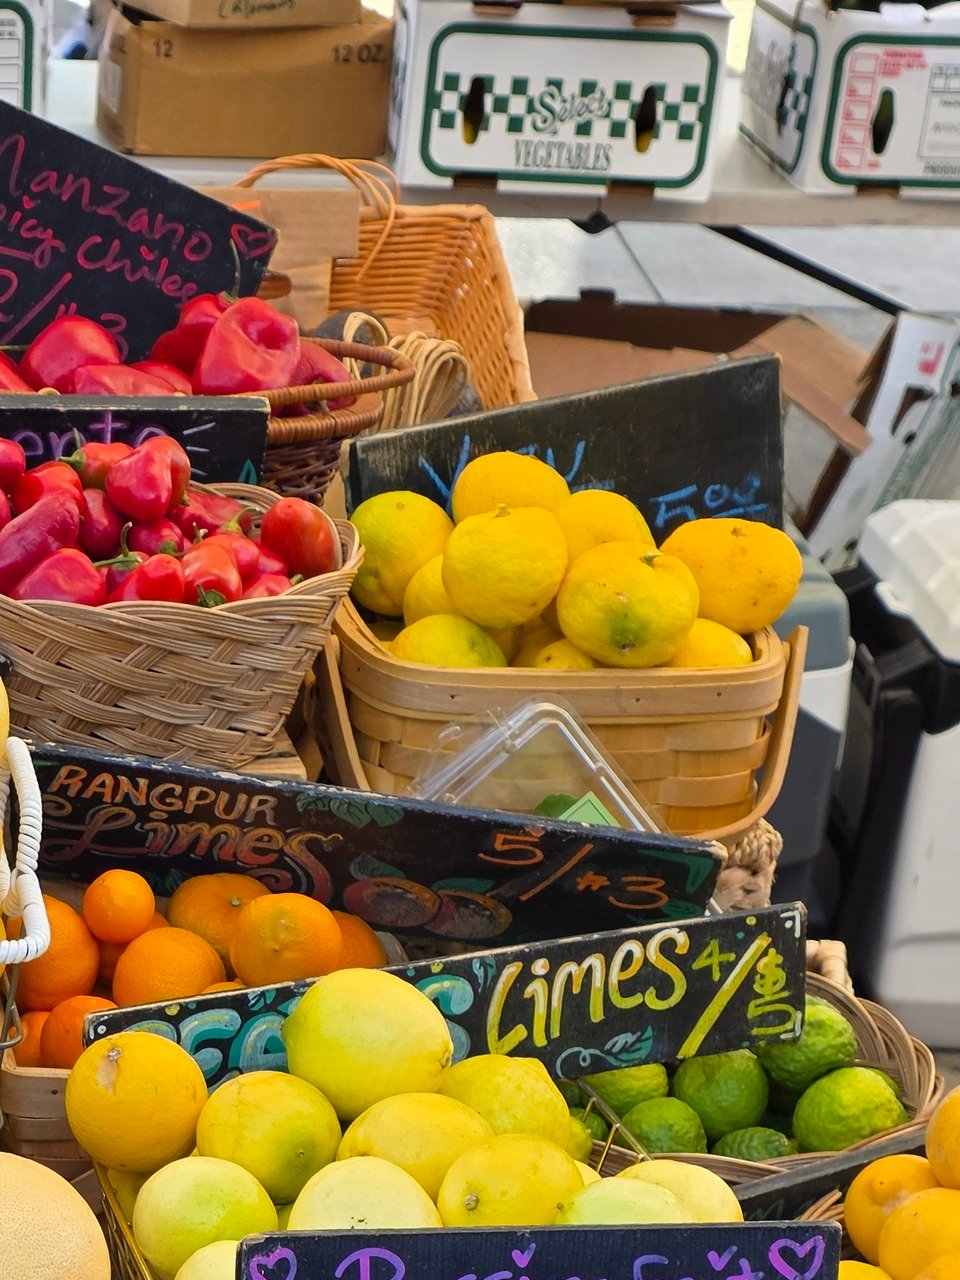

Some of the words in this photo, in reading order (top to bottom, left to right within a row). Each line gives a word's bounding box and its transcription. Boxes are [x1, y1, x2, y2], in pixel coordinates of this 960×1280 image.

[154, 38, 174, 58] 12
[332, 43, 352, 65] 12
[515, 139, 613, 171] VEGETABLES
[47, 765, 279, 826] RANGPUR
[41, 794, 344, 906] Limes
